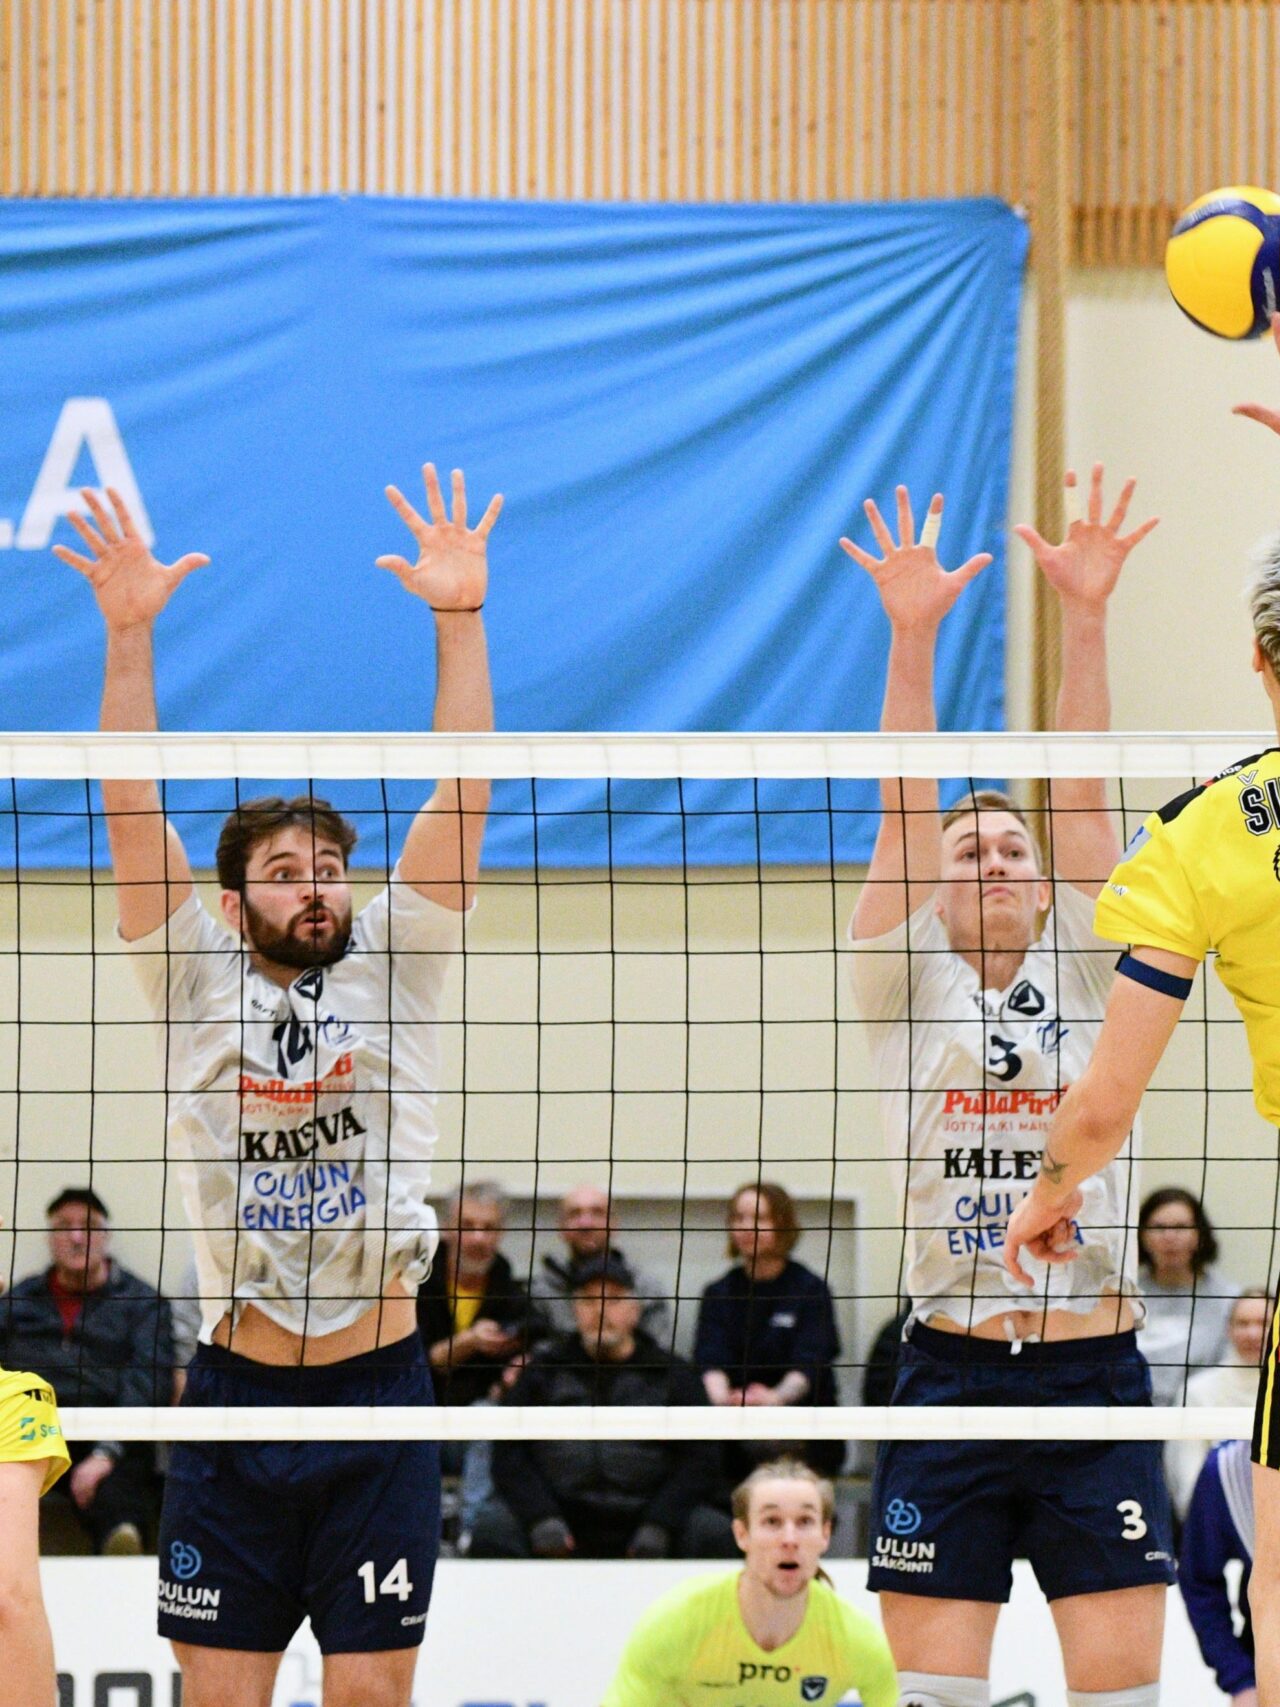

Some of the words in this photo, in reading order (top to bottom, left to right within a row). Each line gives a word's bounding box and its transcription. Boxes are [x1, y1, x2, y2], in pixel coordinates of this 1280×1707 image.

[0, 396, 156, 550] A
[987, 1034, 1023, 1082] 3
[943, 1148, 1043, 1180] KALE
[1116, 1499, 1148, 1541] 3
[875, 1536, 936, 1560] ULUN
[357, 1558, 414, 1604] 14
